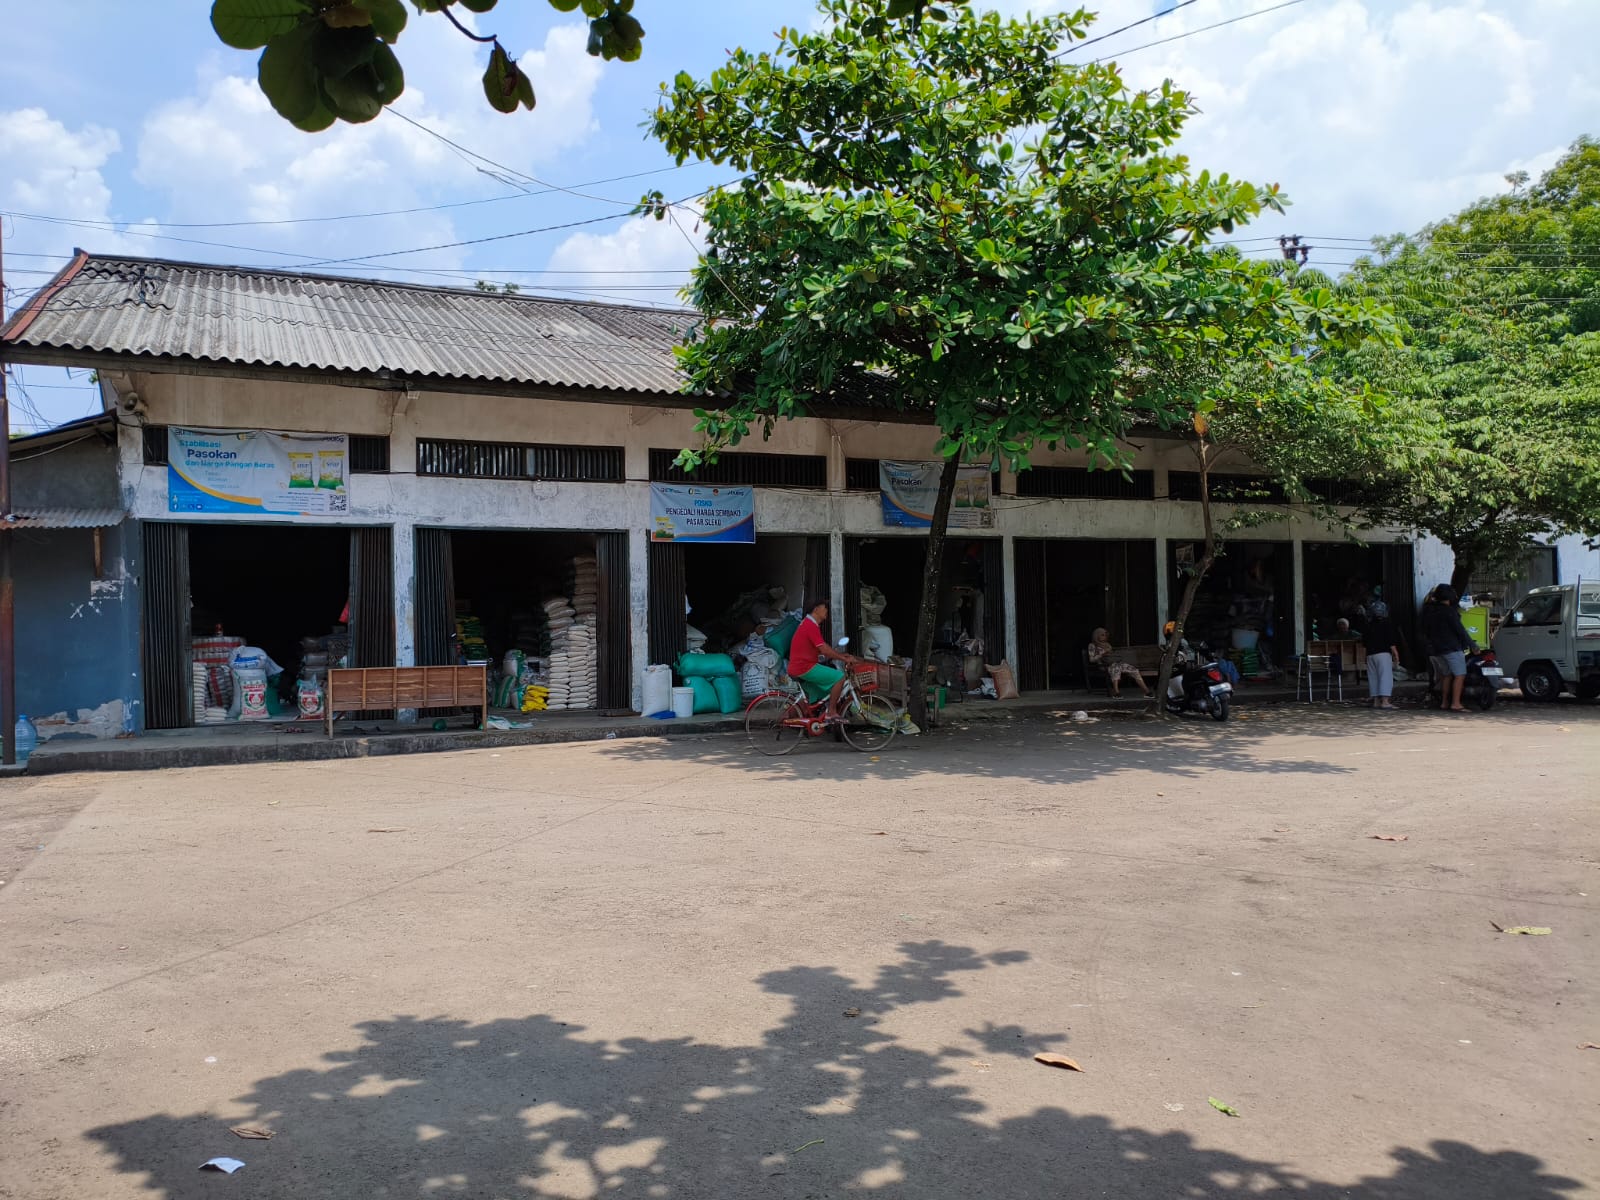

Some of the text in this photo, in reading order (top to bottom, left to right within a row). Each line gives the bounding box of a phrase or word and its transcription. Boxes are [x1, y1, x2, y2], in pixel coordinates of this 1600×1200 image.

[180, 440, 222, 448] Stabilisasi
[187, 448, 237, 459] Pasokan
[201, 460, 224, 468] Harga
[225, 461, 253, 469] Pangan
[892, 478, 922, 486] Pasokan
[696, 508, 715, 517] HARGA
[716, 508, 741, 517] SEMBAKO
[686, 518, 704, 526] PASAR
